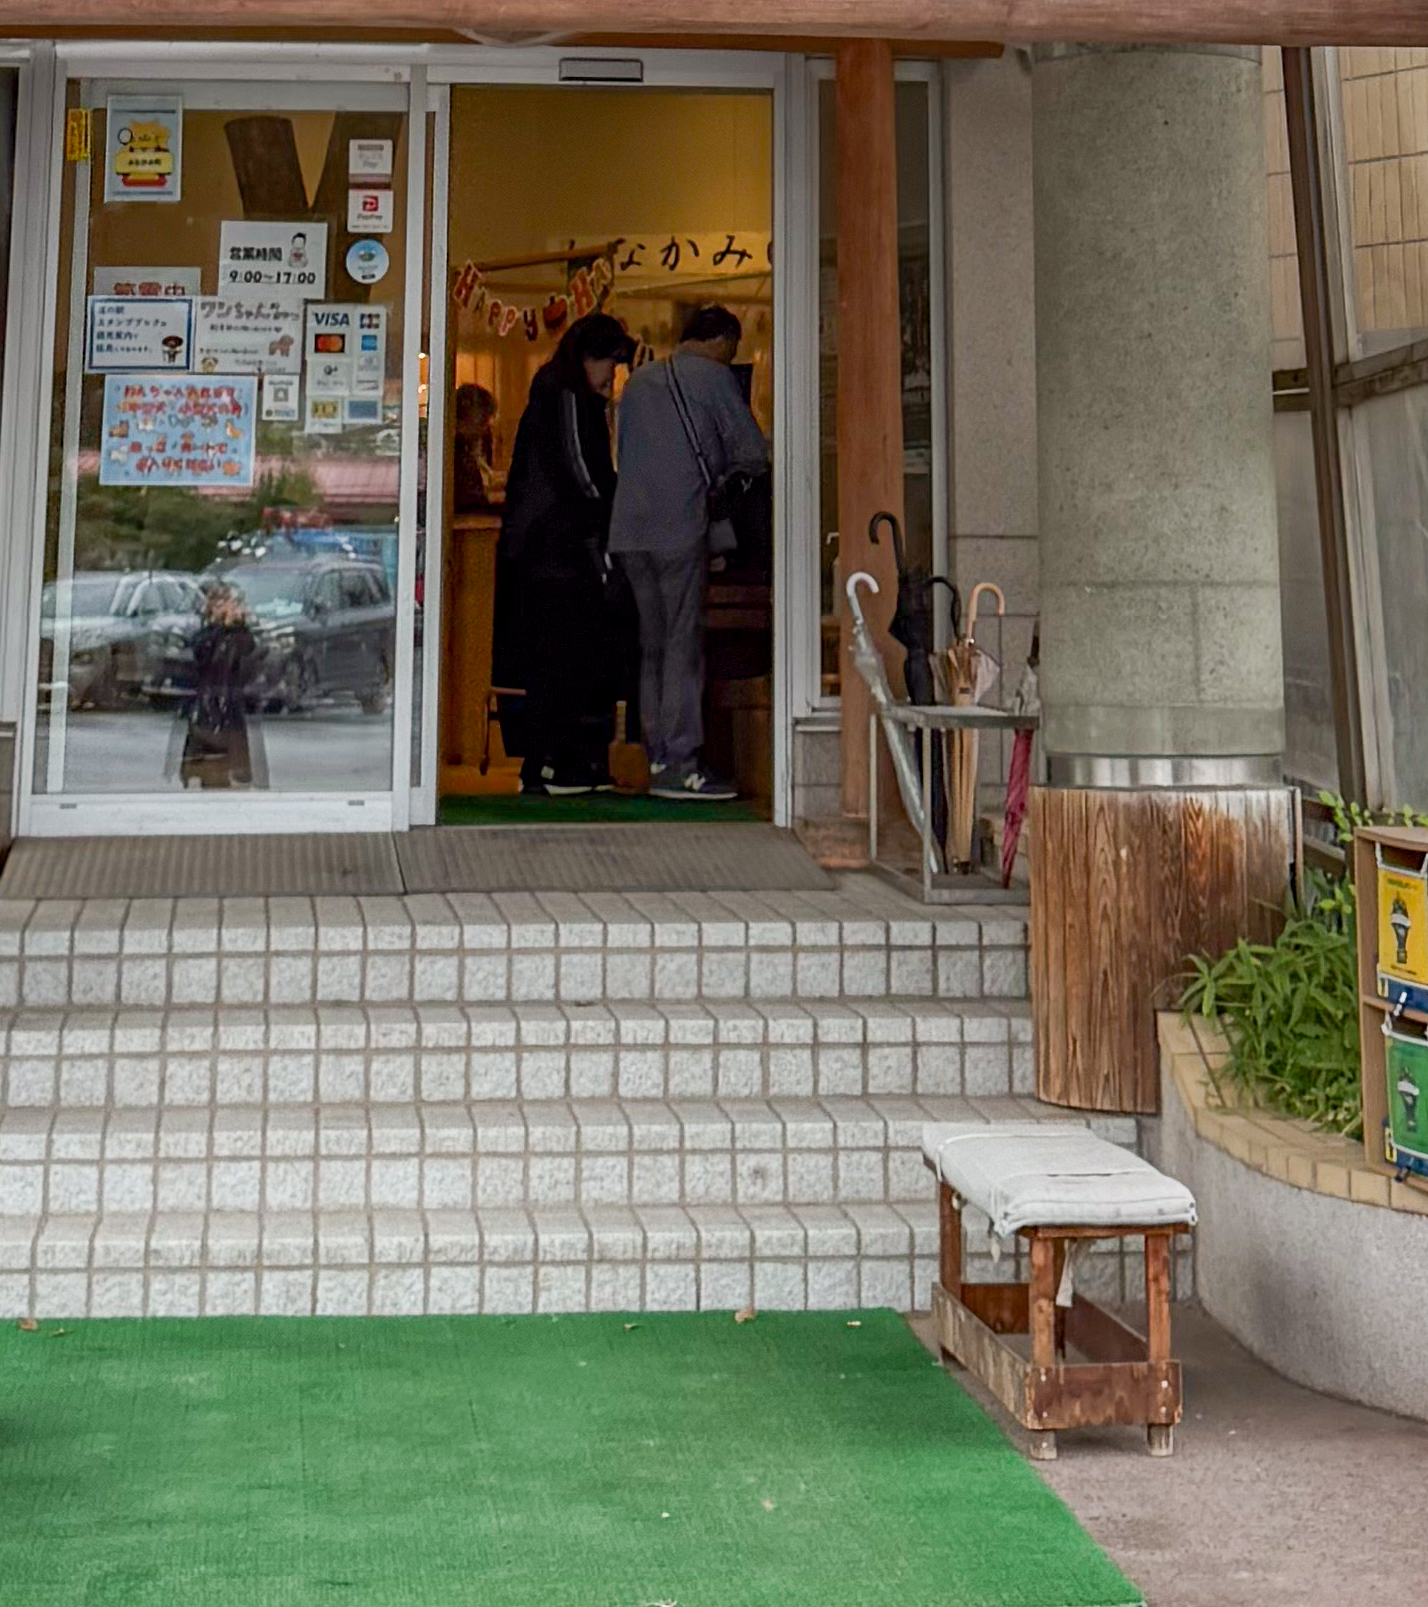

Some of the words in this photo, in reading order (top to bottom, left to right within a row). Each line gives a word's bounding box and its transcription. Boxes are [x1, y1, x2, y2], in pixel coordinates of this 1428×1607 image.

[229, 247, 283, 262] 営業時間
[314, 312, 350, 326] VISA
